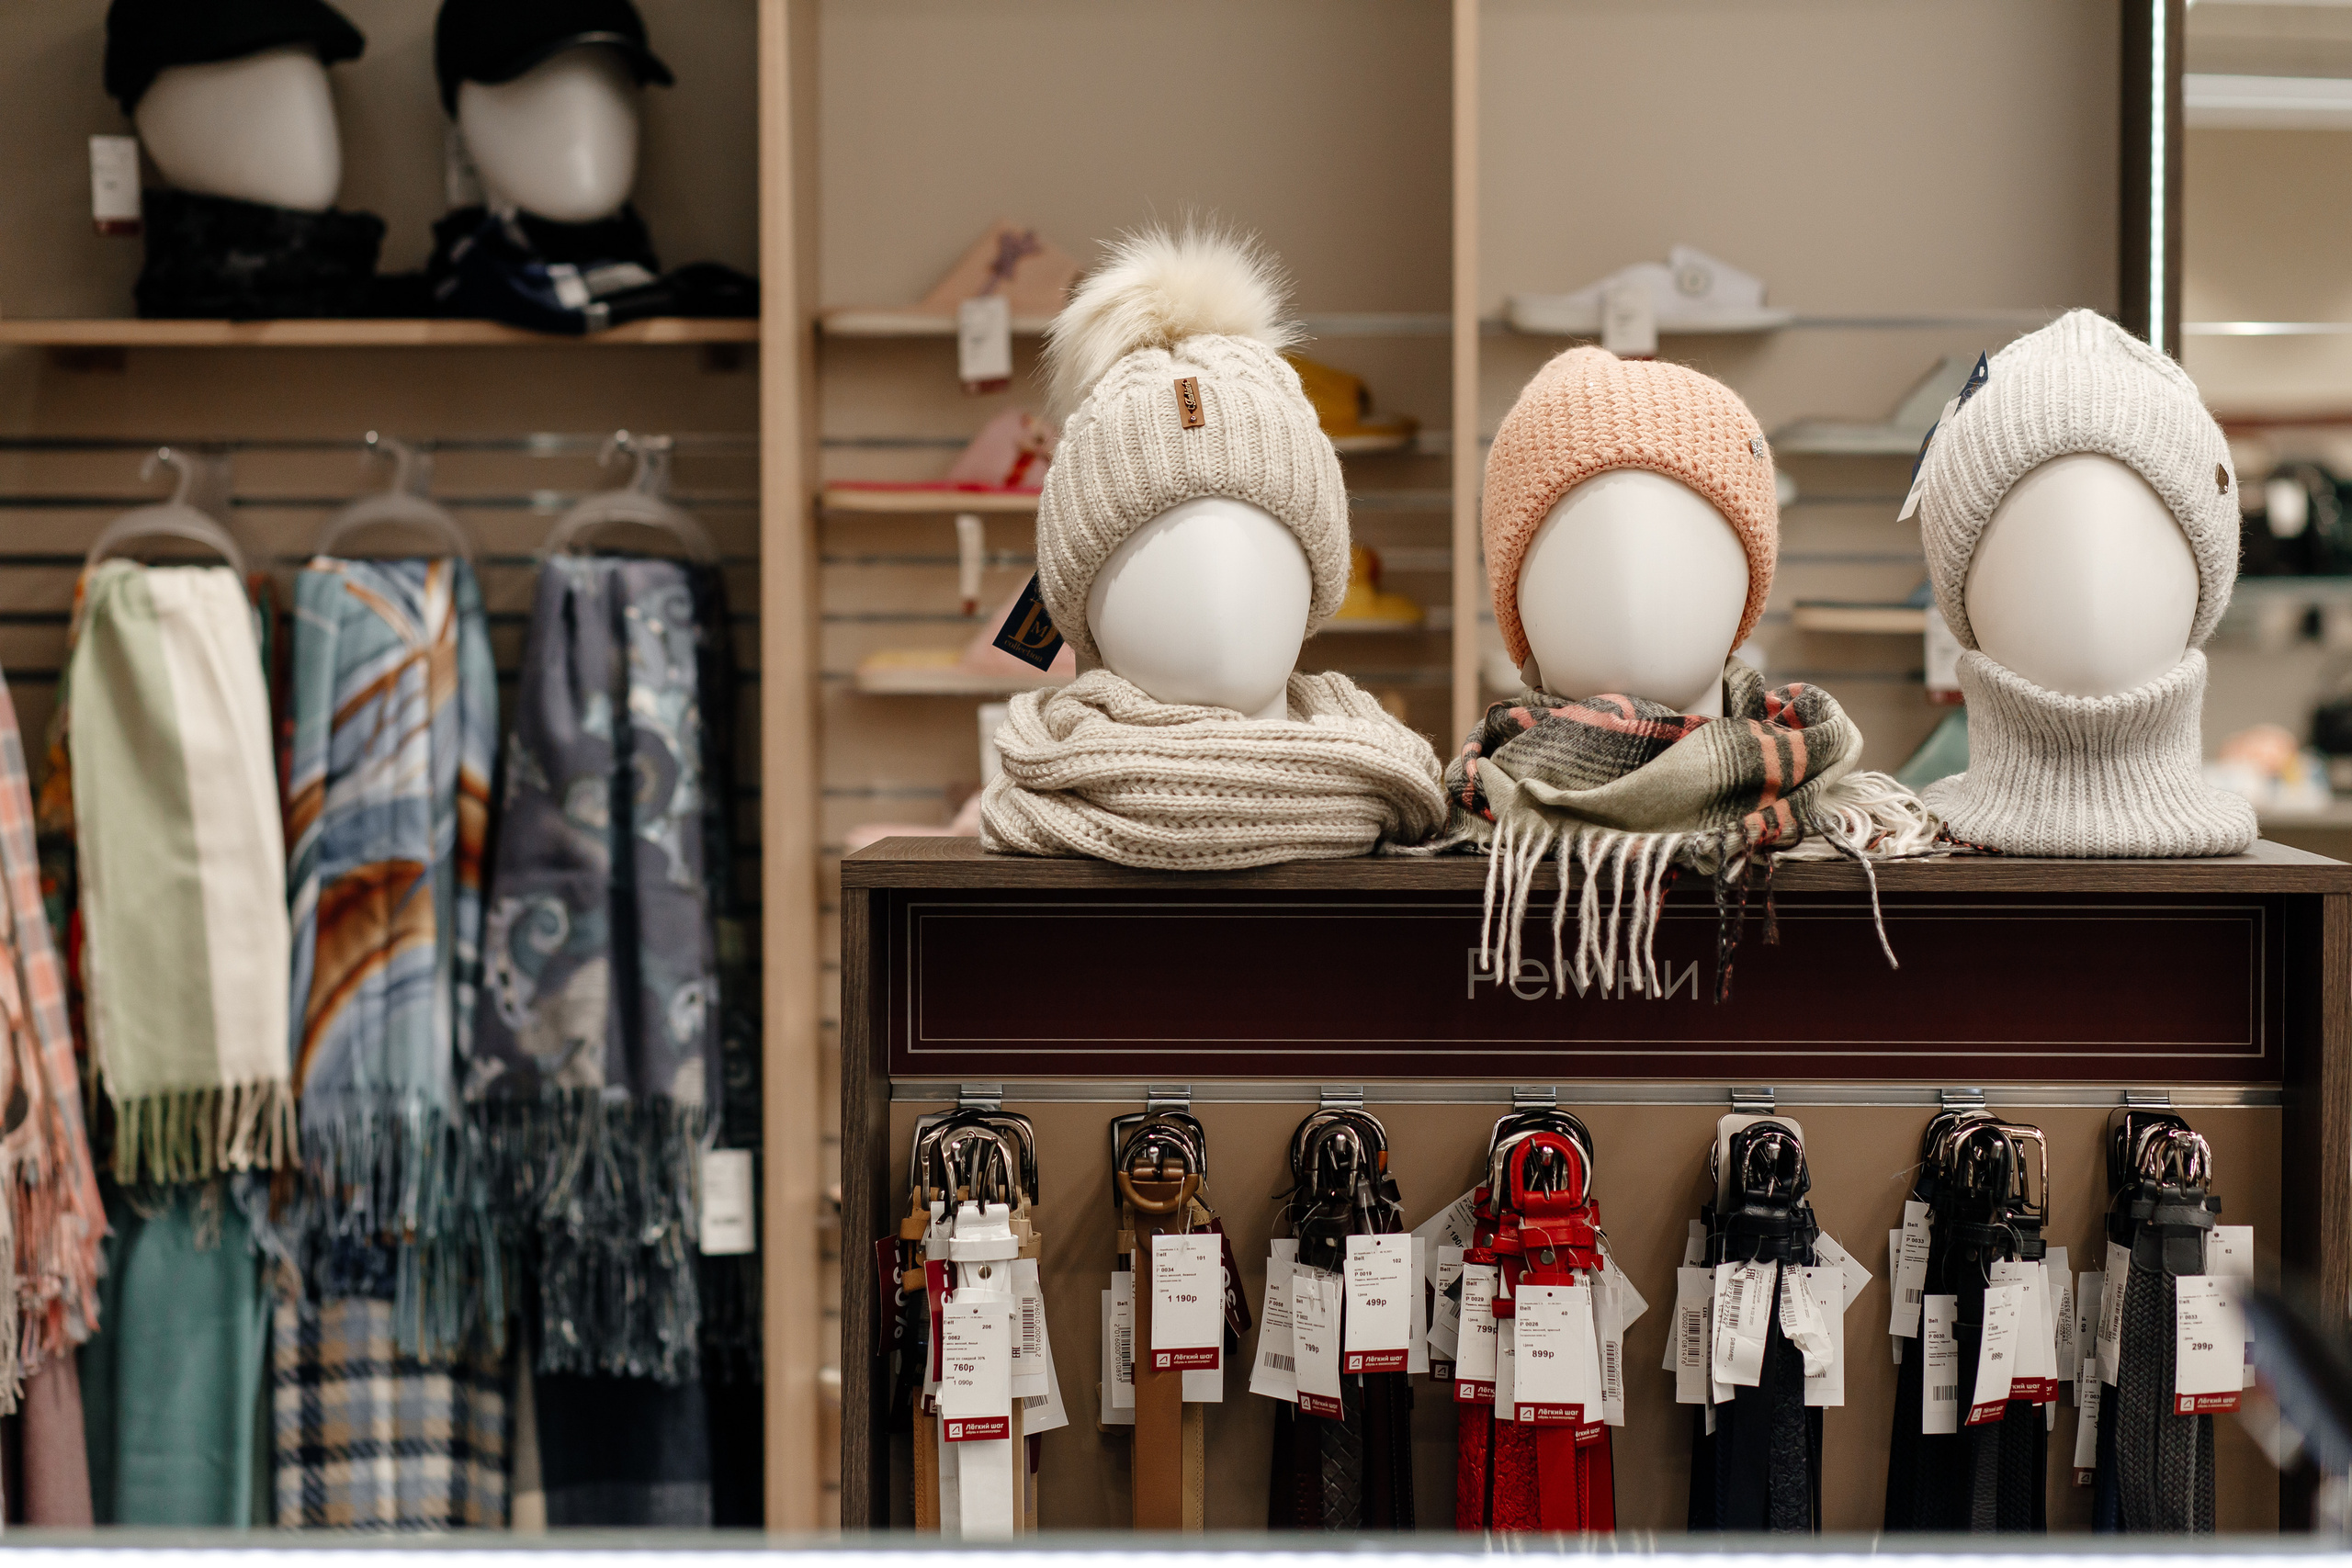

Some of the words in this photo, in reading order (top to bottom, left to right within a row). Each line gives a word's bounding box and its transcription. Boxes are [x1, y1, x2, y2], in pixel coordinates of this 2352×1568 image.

[1004, 639, 1043, 662] collection
[1467, 947, 1699, 1000] Ремни
[1727, 1337, 1736, 1362] размер
[1575, 1429, 1590, 1438] ёгкий
